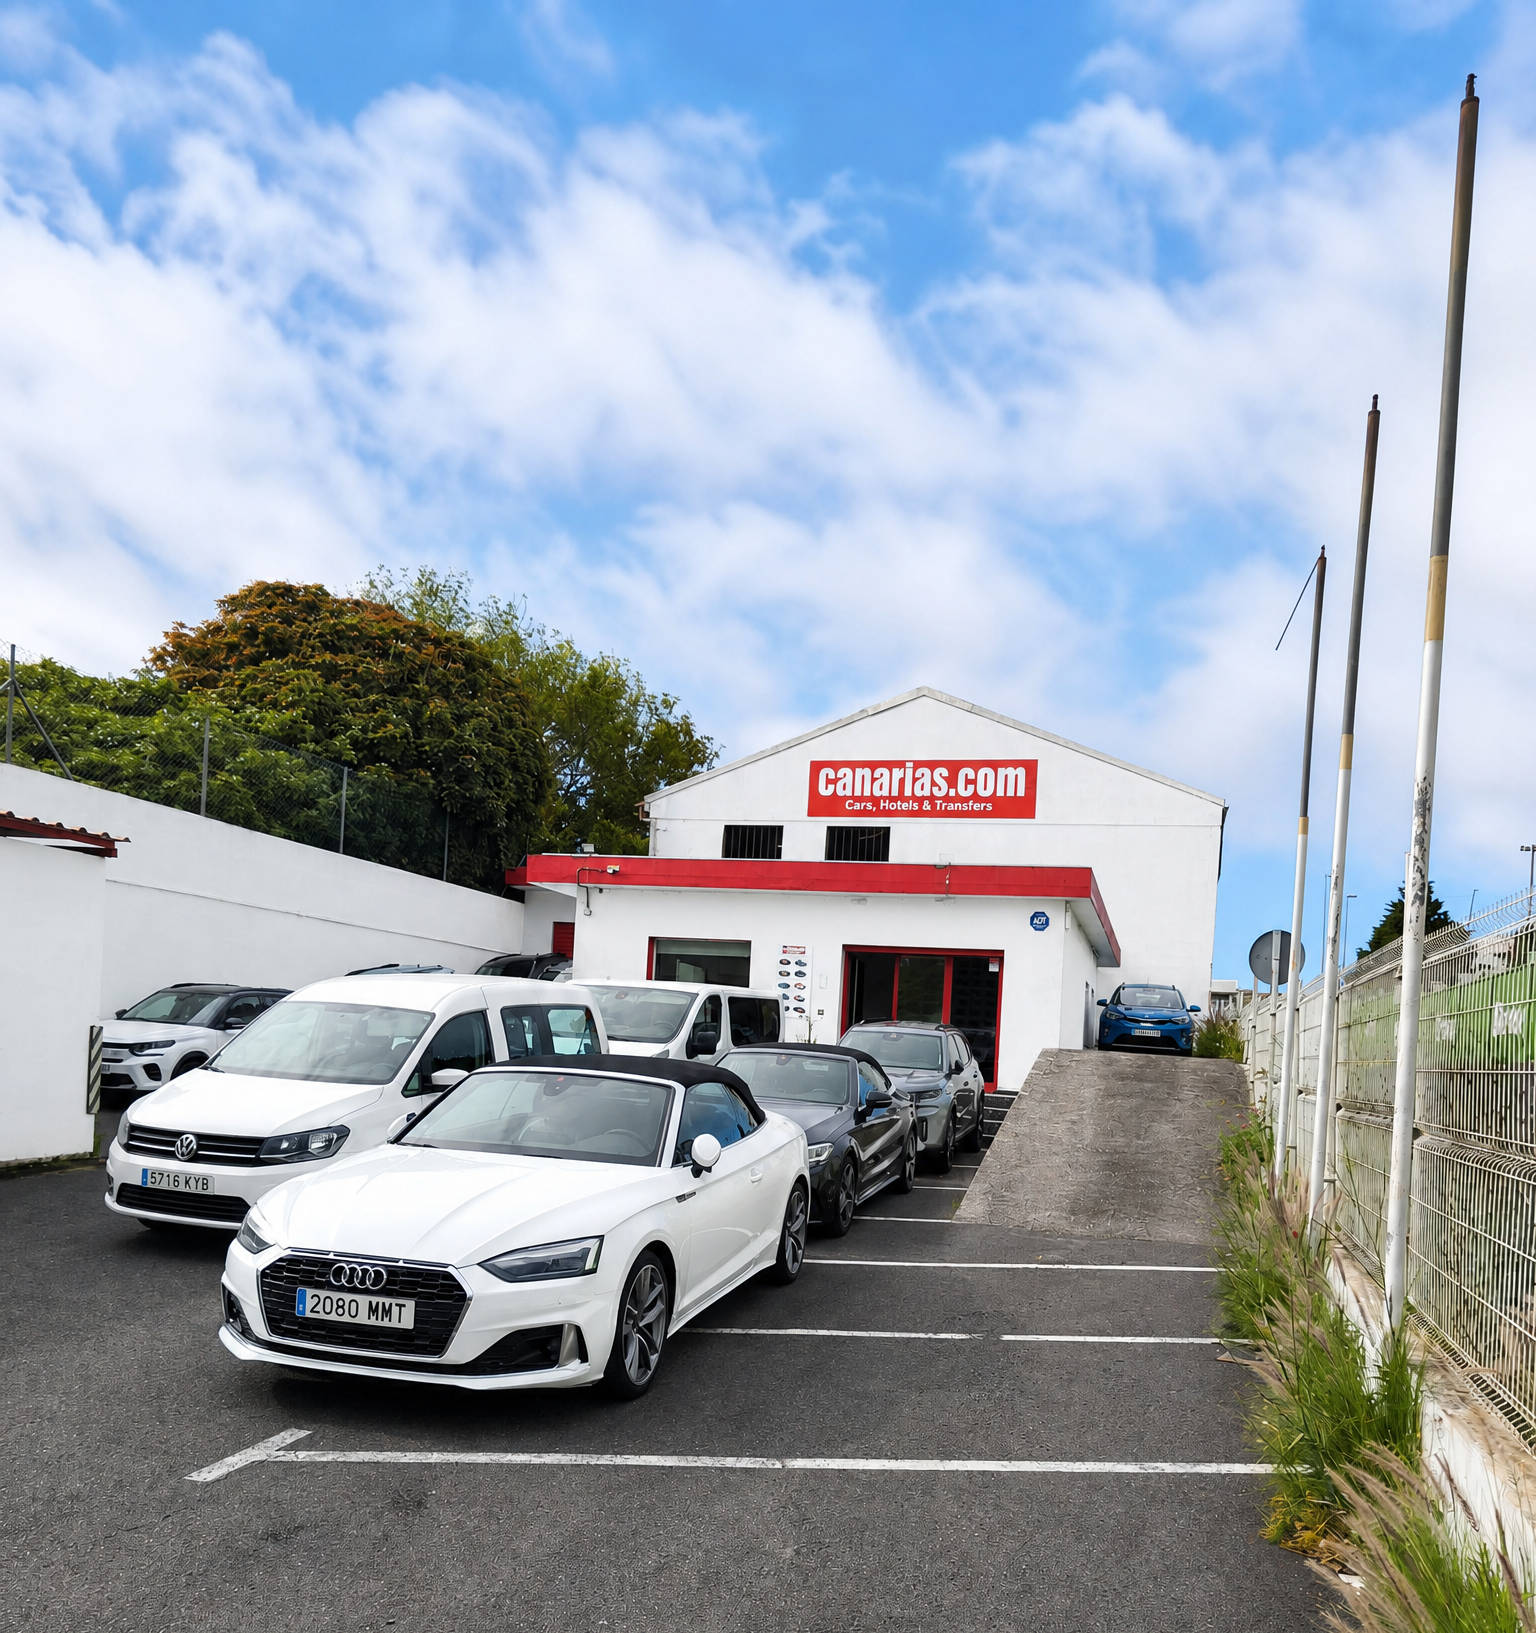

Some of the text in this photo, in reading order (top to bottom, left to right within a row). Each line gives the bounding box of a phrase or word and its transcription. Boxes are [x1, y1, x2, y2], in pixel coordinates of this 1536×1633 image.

[818, 762, 1026, 797] canarias.com
[845, 799, 993, 812] Cars, Hotels & Transfers
[150, 1171, 209, 1191] 5716 KYB
[309, 1294, 406, 1324] 2080 MMT
